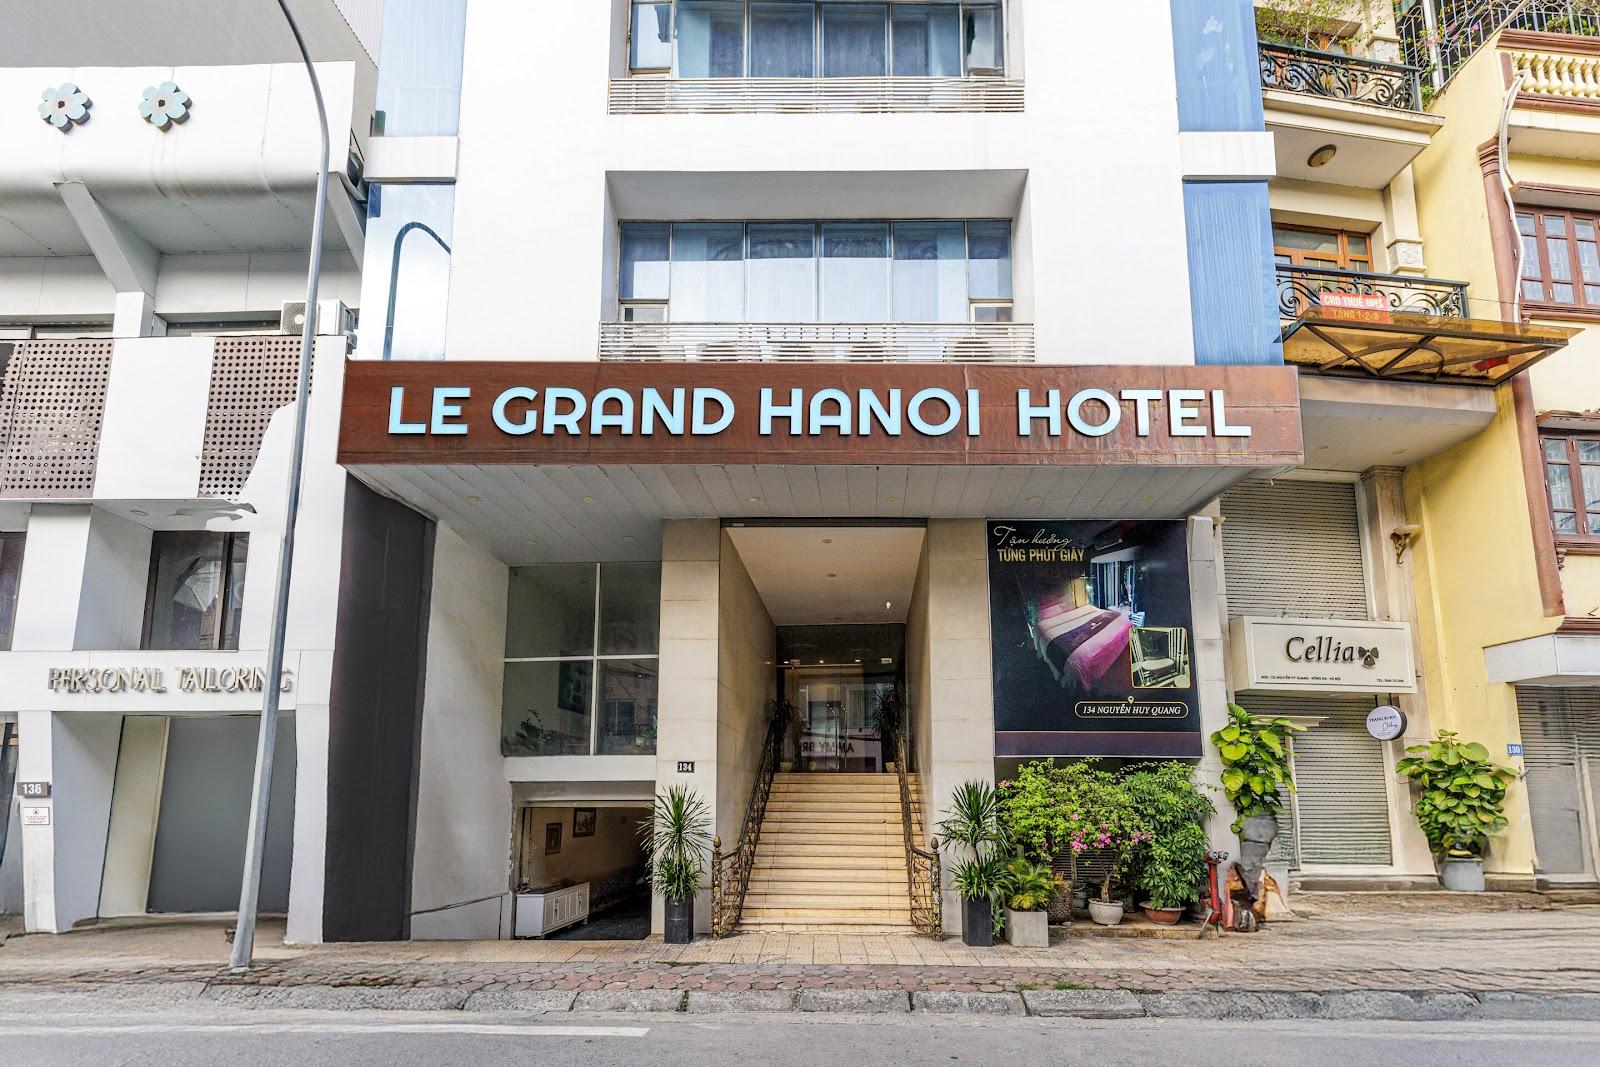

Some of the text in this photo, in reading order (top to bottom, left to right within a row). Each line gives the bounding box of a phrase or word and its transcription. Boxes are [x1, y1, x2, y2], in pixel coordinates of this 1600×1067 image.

[387, 386, 1252, 437] LE GRAND HANOI HOTEL
[997, 546, 1026, 562] TỪNG
[1029, 546, 1057, 562] PHÚT
[1285, 635, 1356, 662] Cellia
[48, 667, 165, 692] PERSONAL
[1083, 704, 1181, 715] 134 NGUYỄN HUY QUANG
[1508, 745, 1521, 754] 130
[679, 762, 693, 771] 134
[22, 783, 42, 795] 136
